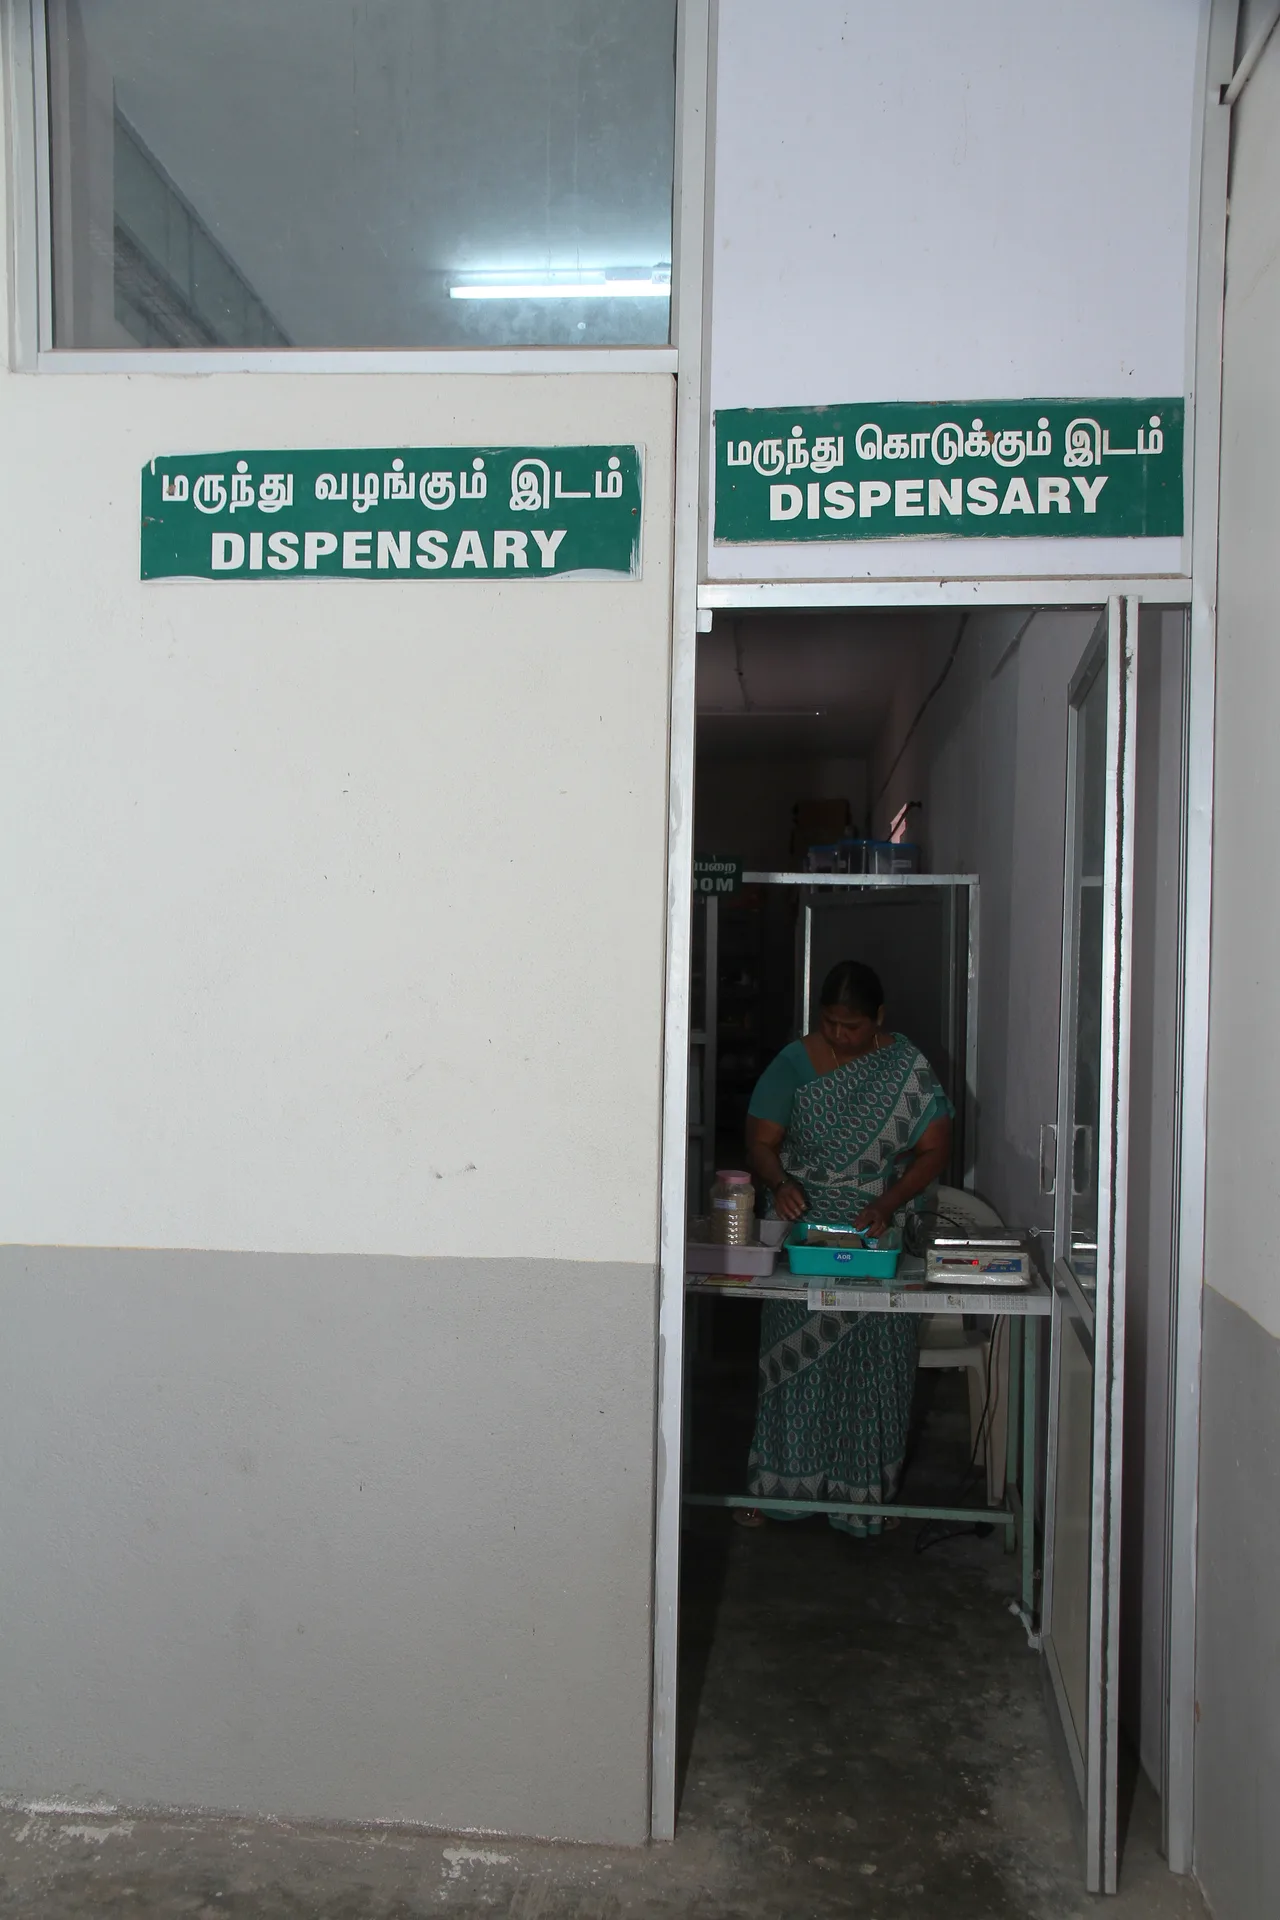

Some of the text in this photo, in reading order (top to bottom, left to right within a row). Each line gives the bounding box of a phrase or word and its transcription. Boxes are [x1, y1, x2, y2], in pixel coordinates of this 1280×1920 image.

[727, 415, 1164, 477] மருந்து கொடுக்கும் இடம்
[162, 456, 623, 514] மருந்து வழங்கும் இடம்
[769, 476, 1109, 521] DISPENSARY
[211, 529, 568, 571] DISPENSARY
